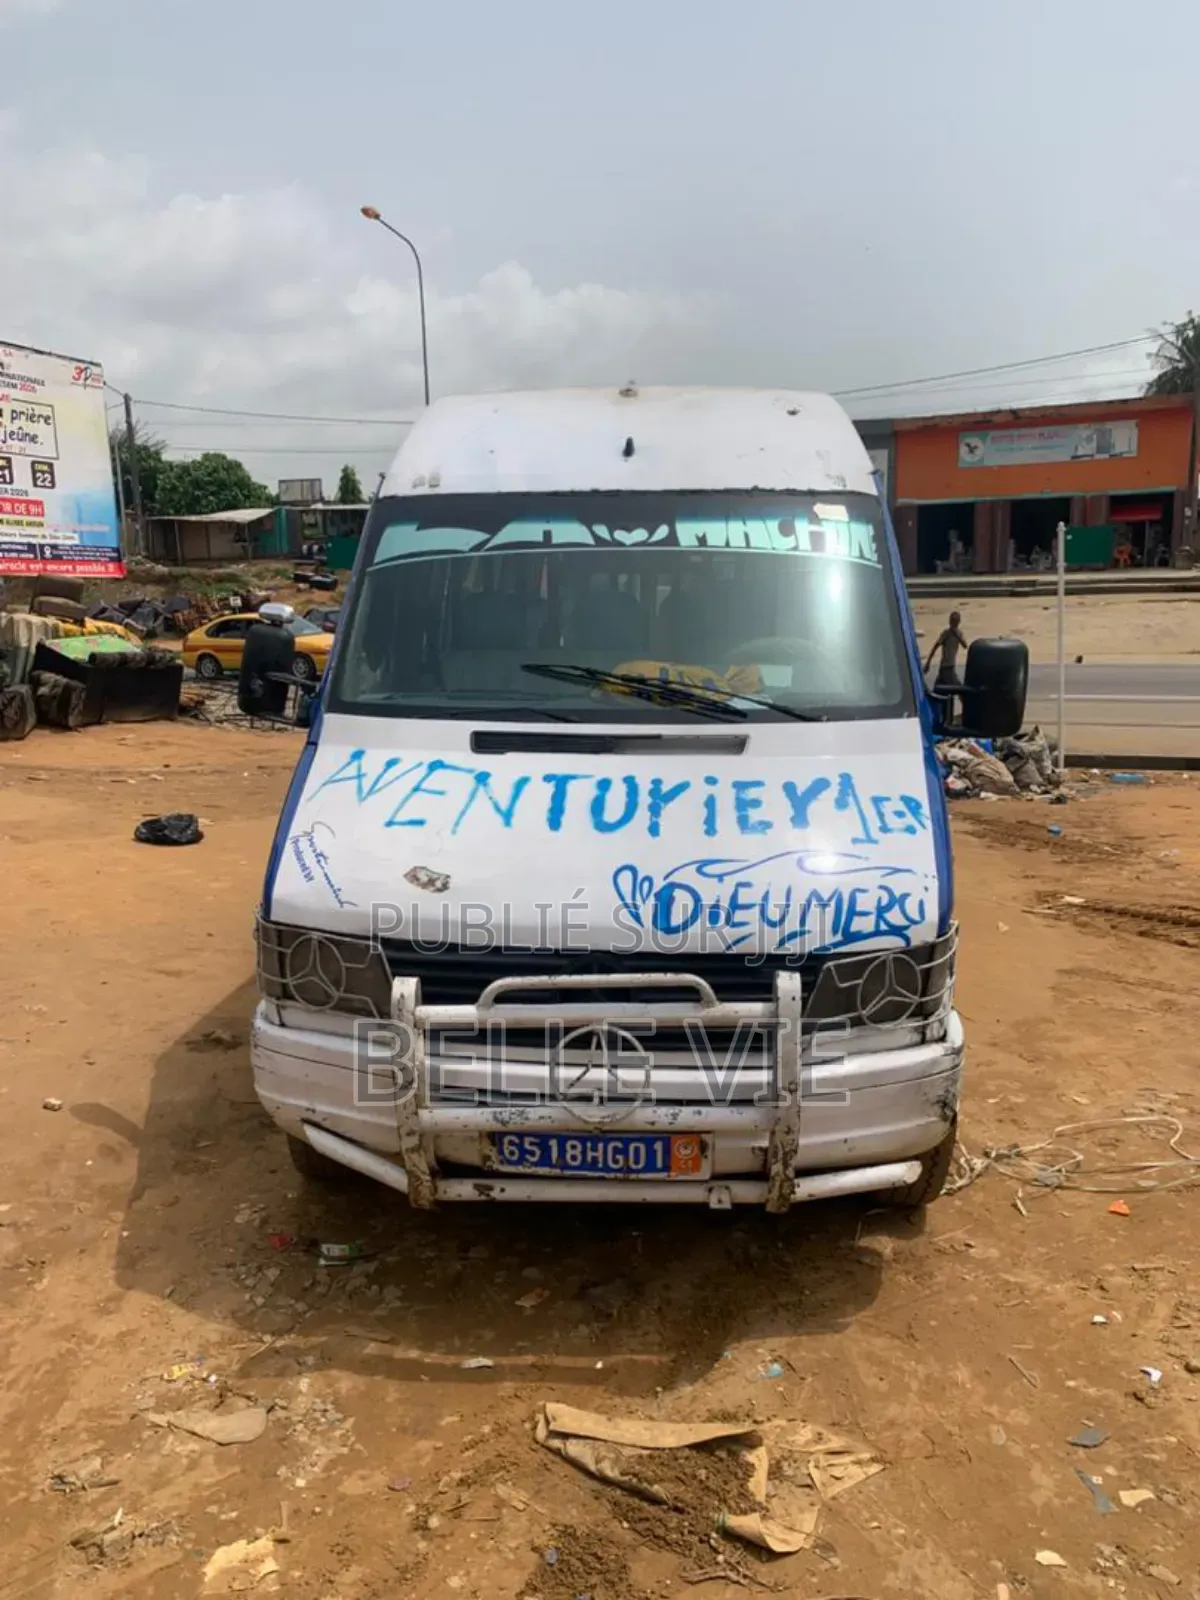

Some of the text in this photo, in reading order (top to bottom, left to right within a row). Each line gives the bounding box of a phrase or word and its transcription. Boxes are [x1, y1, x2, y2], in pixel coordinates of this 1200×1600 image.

[11, 406, 52, 426] prière
[1, 424, 44, 446] jeûne.
[36, 472, 52, 487] 22
[14, 503, 27, 514] DE
[29, 562, 43, 572] est
[502, 1134, 664, 1171] 6518HG01
